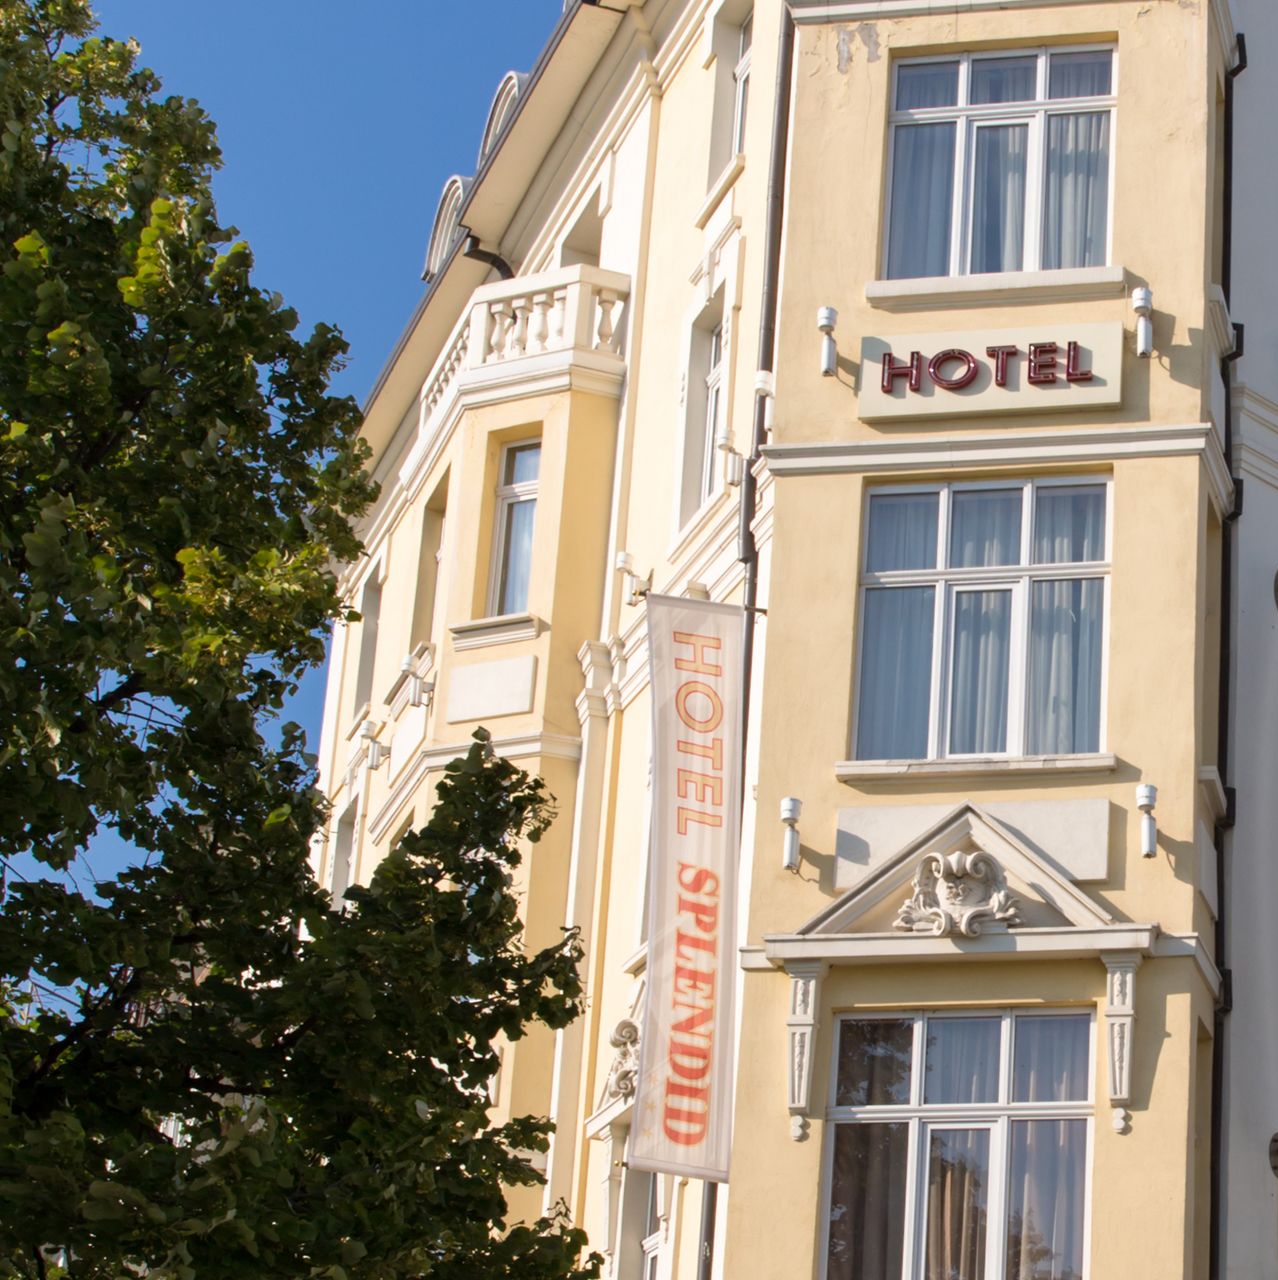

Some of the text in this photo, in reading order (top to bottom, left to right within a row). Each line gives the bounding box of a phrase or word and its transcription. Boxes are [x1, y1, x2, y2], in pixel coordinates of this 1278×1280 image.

[881, 341, 1093, 393] HOTEL
[663, 630, 723, 1147] HOTEL SPLENDID
